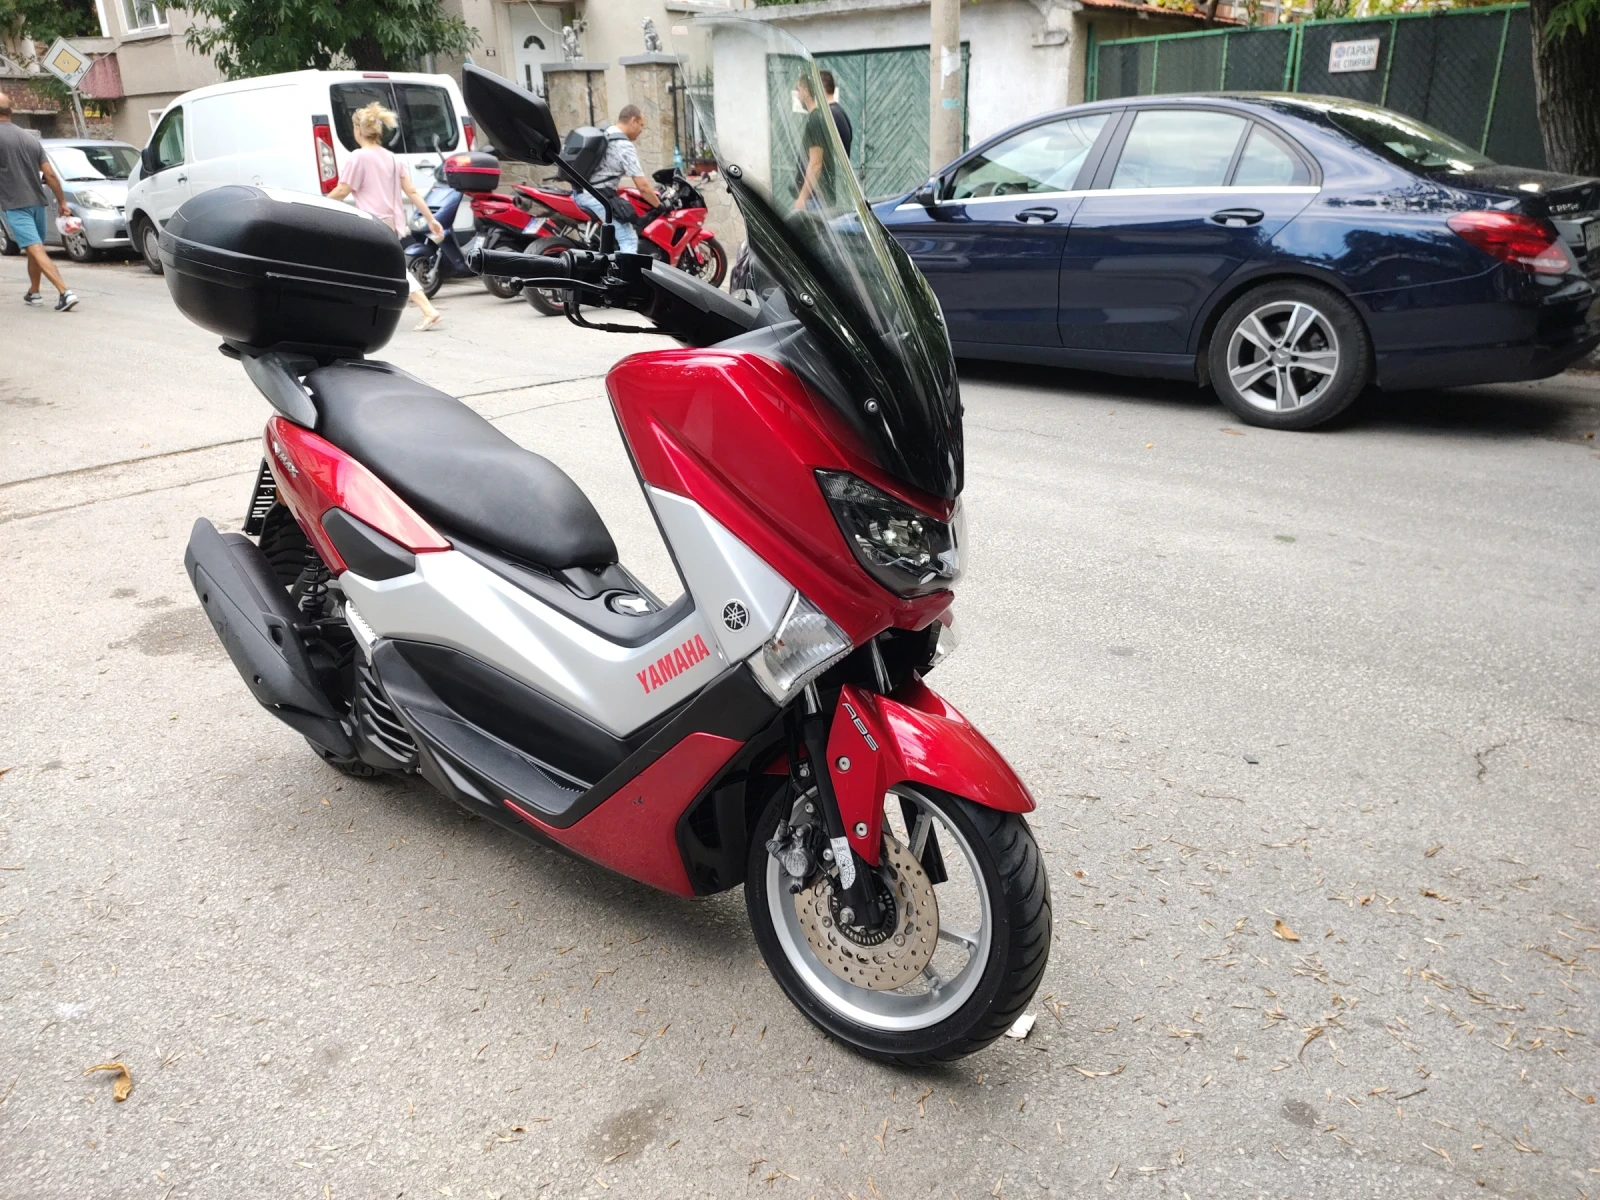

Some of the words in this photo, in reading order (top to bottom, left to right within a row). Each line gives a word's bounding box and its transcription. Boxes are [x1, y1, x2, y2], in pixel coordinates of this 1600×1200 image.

[1332, 60, 1341, 69] НЕ
[1346, 44, 1376, 57] ГАРАЖ
[636, 633, 710, 694] YAMAHA
[841, 702, 879, 751] ABS
